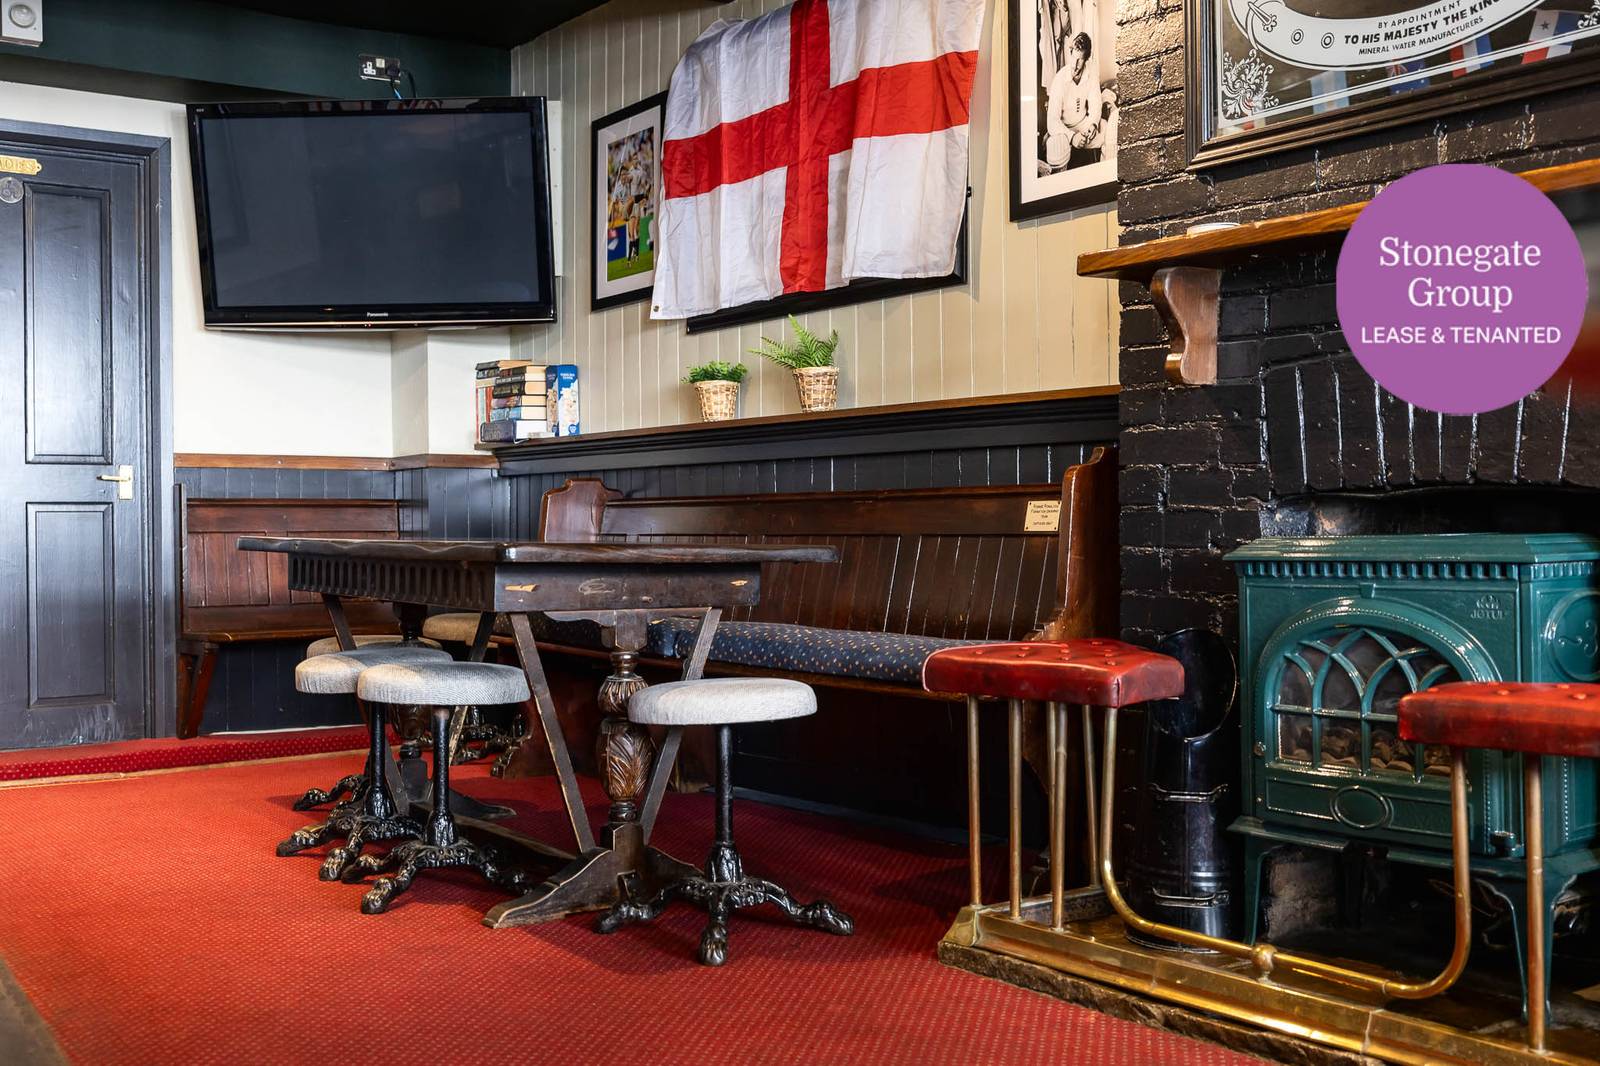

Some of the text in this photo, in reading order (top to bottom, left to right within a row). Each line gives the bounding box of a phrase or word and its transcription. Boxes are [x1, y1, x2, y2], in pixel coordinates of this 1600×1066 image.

[1344, 0, 1501, 44] TO HIS MAJESTY THE KIN
[1391, 0, 1460, 27] APPOINTMENT
[1359, 15, 1484, 55] MINERAL WATER MANUFACTURERS
